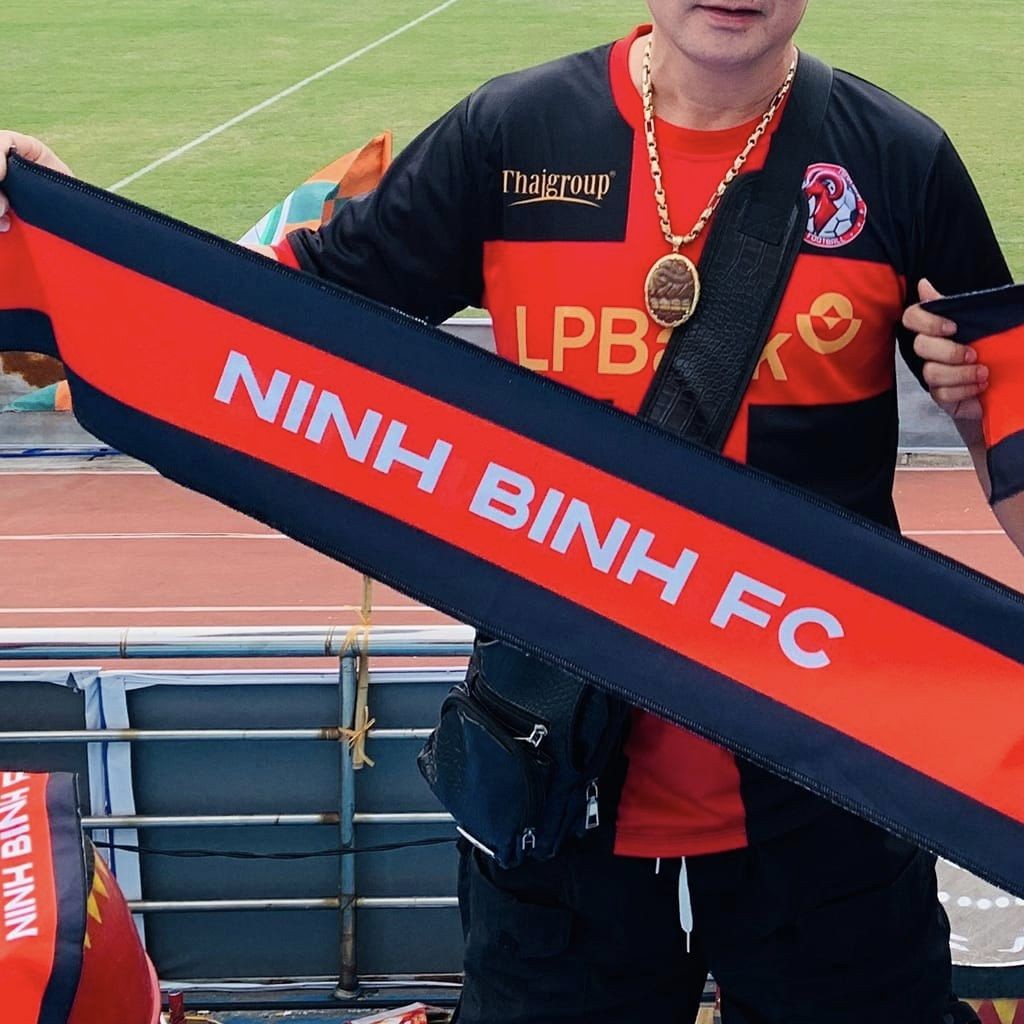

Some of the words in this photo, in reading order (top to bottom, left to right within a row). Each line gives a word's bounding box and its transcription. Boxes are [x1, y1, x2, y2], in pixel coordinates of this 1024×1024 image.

[502, 168, 610, 200] Thaigroup
[515, 305, 792, 381] LPBk
[214, 351, 453, 493] NINH
[469, 461, 699, 606] BINH
[710, 571, 845, 669] FC
[0, 787, 32, 859] BINH
[2, 862, 38, 941] NINH
